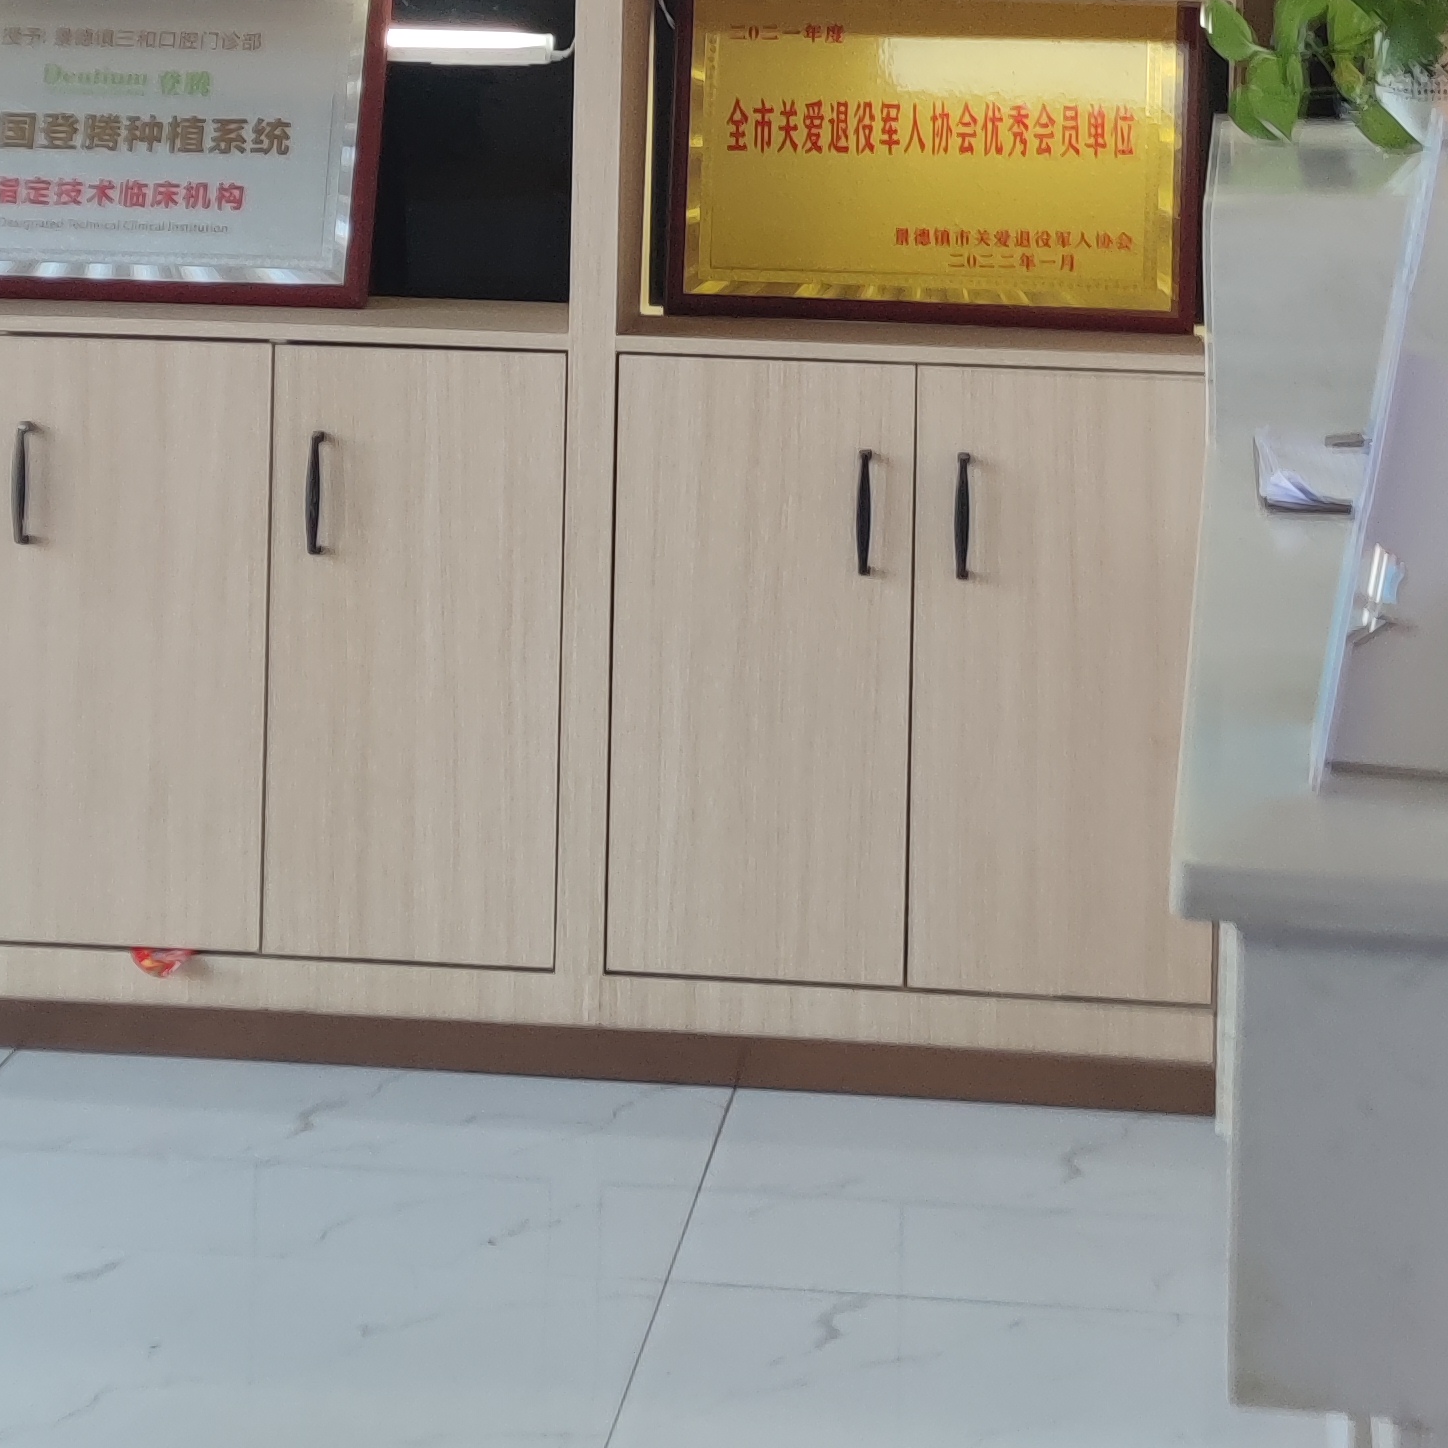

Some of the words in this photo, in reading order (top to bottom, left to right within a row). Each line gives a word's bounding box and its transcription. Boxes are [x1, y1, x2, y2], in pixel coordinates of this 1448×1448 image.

[43, 63, 148, 86] Dentium
[726, 97, 1135, 159] 全市关爱退役军人协会优秀会员单位
[0, 217, 64, 232] Designated
[68, 218, 120, 232] Technical
[122, 219, 165, 233] Clinical
[167, 220, 229, 234] Institution
[894, 227, 1134, 251] 景德镇市关爱退役军人协会
